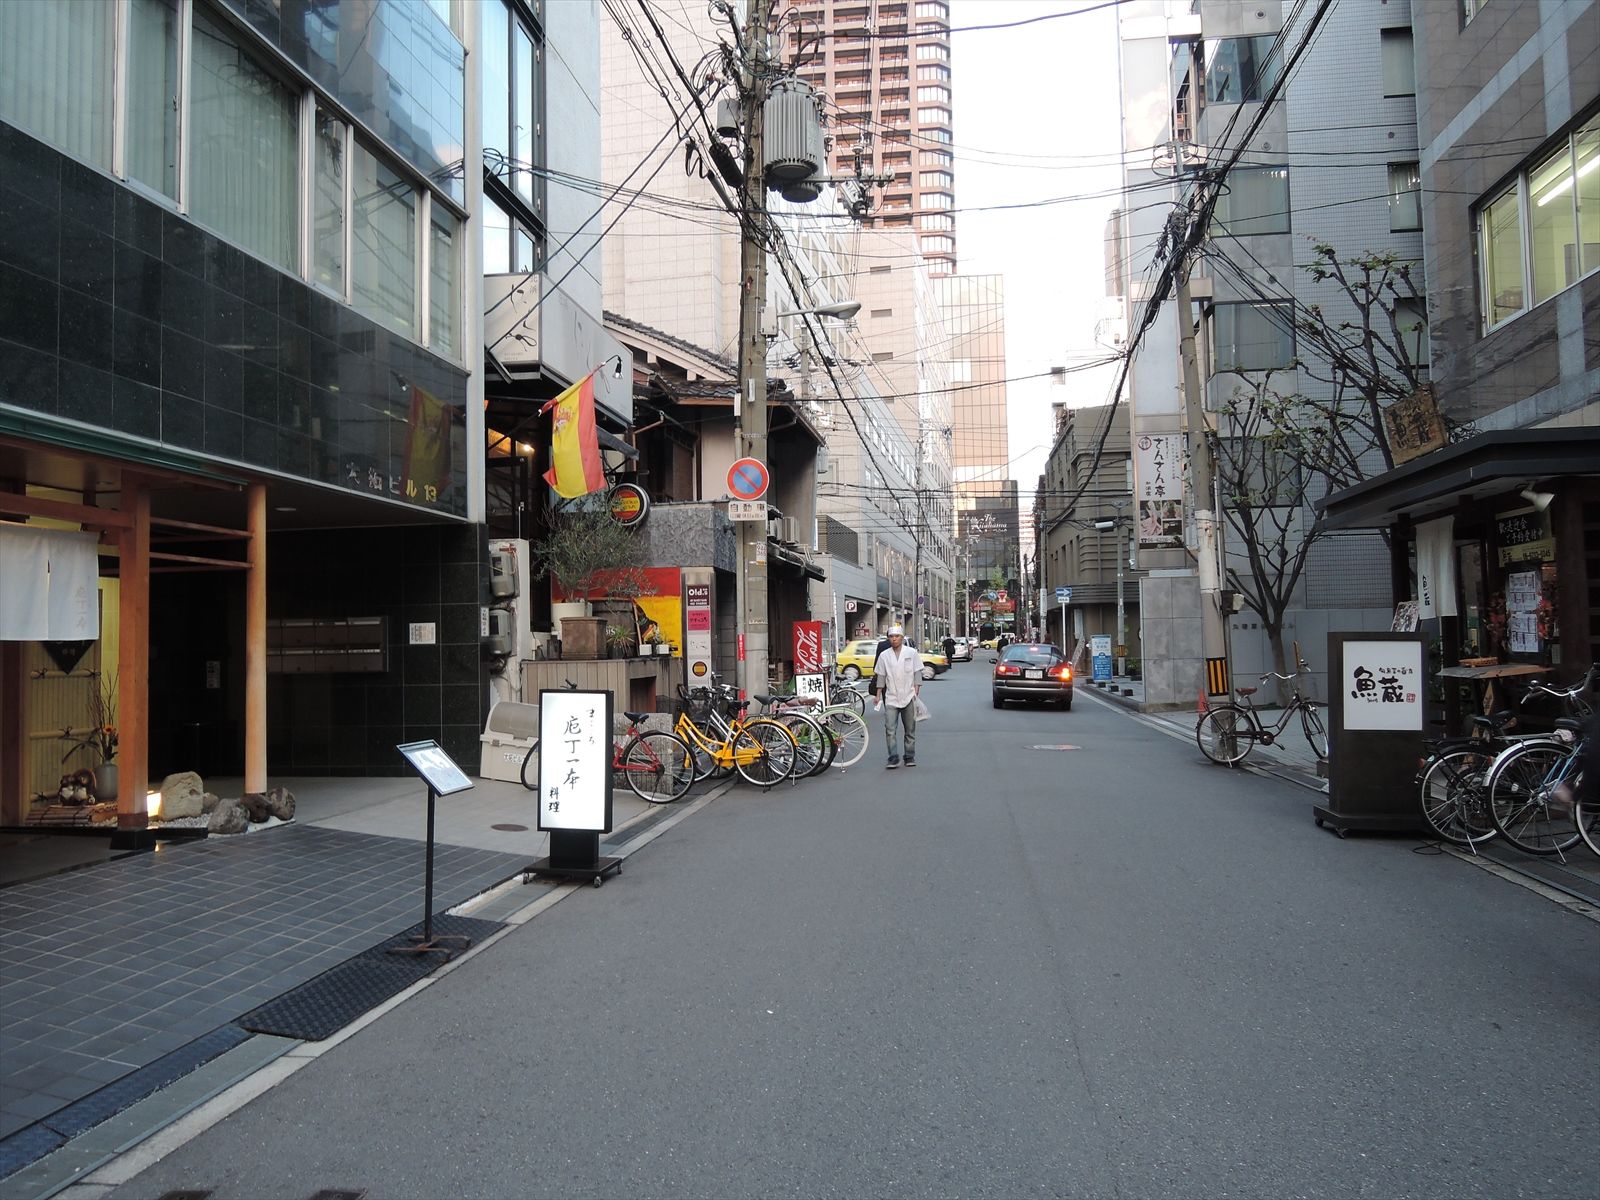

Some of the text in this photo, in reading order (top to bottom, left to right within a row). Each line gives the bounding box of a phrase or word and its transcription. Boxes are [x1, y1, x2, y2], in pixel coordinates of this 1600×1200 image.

[807, 677, 824, 714] 焼肉
[1351, 665, 1405, 703] 魚蔵
[563, 715, 582, 790] 庖丁一本
[548, 786, 560, 813] 料理
